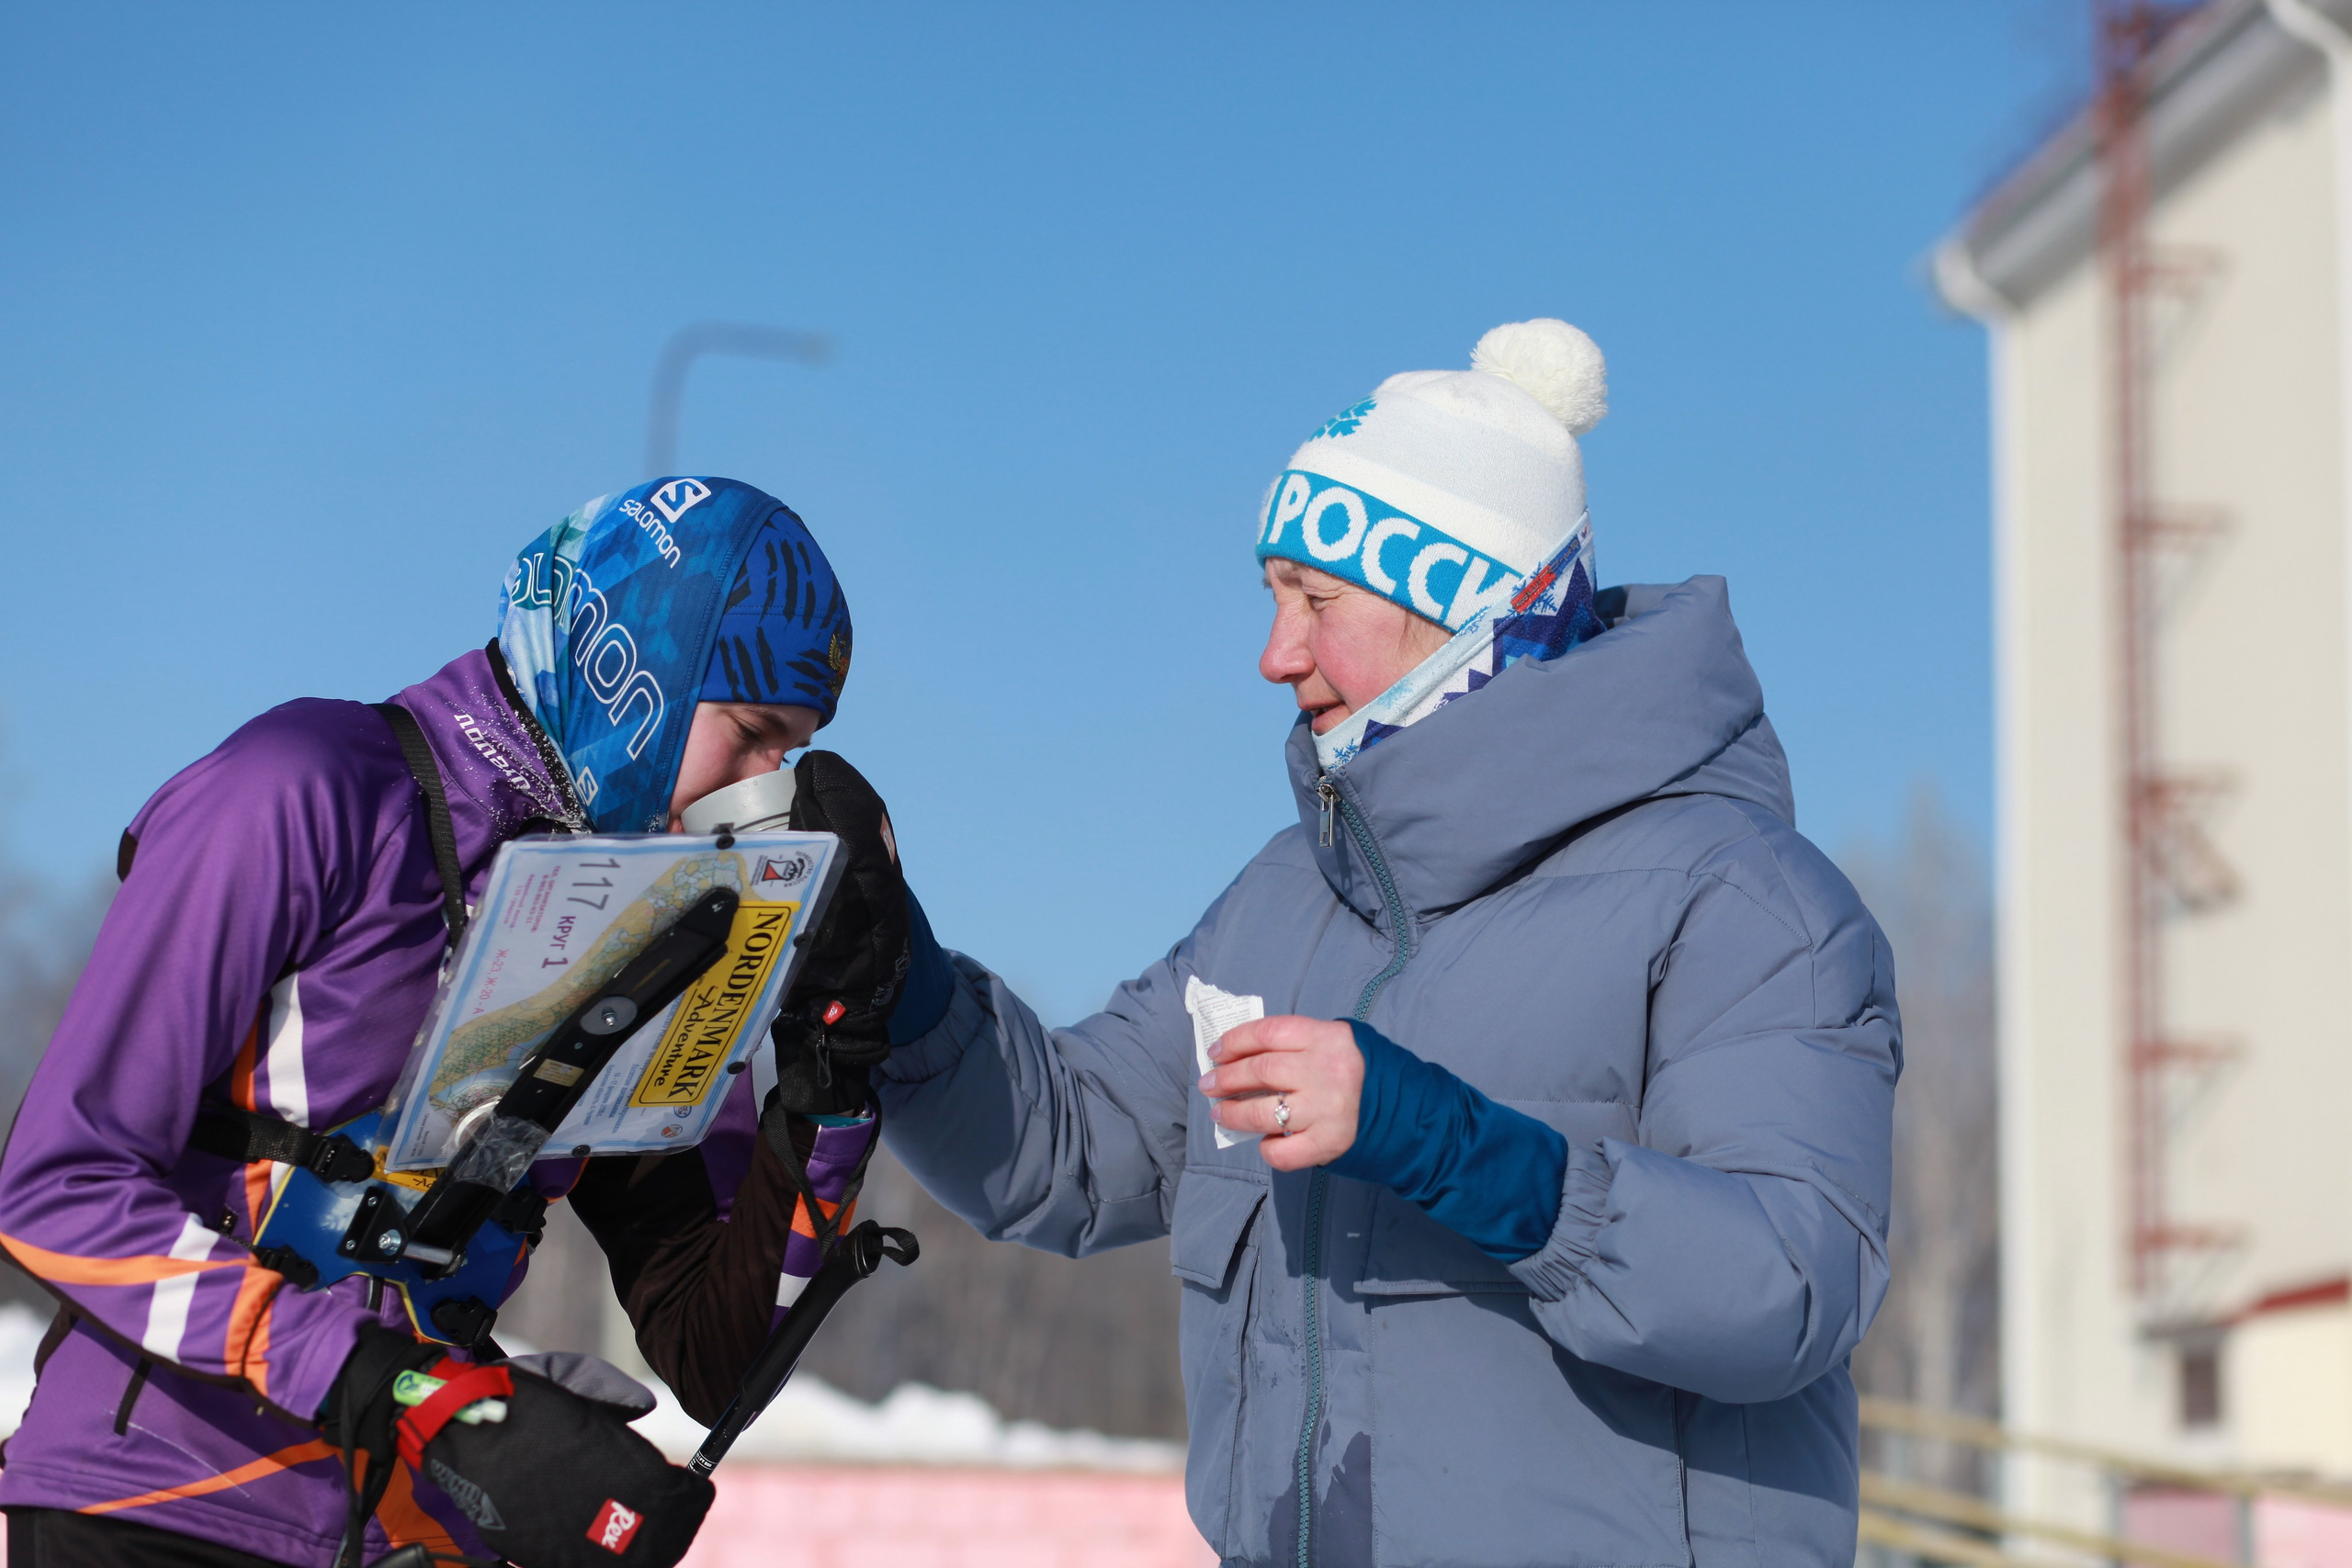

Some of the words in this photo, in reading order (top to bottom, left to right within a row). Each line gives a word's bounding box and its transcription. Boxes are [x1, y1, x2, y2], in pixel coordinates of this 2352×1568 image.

[618, 499, 681, 569] salomon
[567, 858, 621, 910] 117
[549, 916, 576, 951] КРУГ
[541, 957, 569, 968] 1
[666, 911, 785, 1099] NORDENMARK
[652, 985, 718, 1087] Adventure
[602, 1501, 636, 1549] Rex
